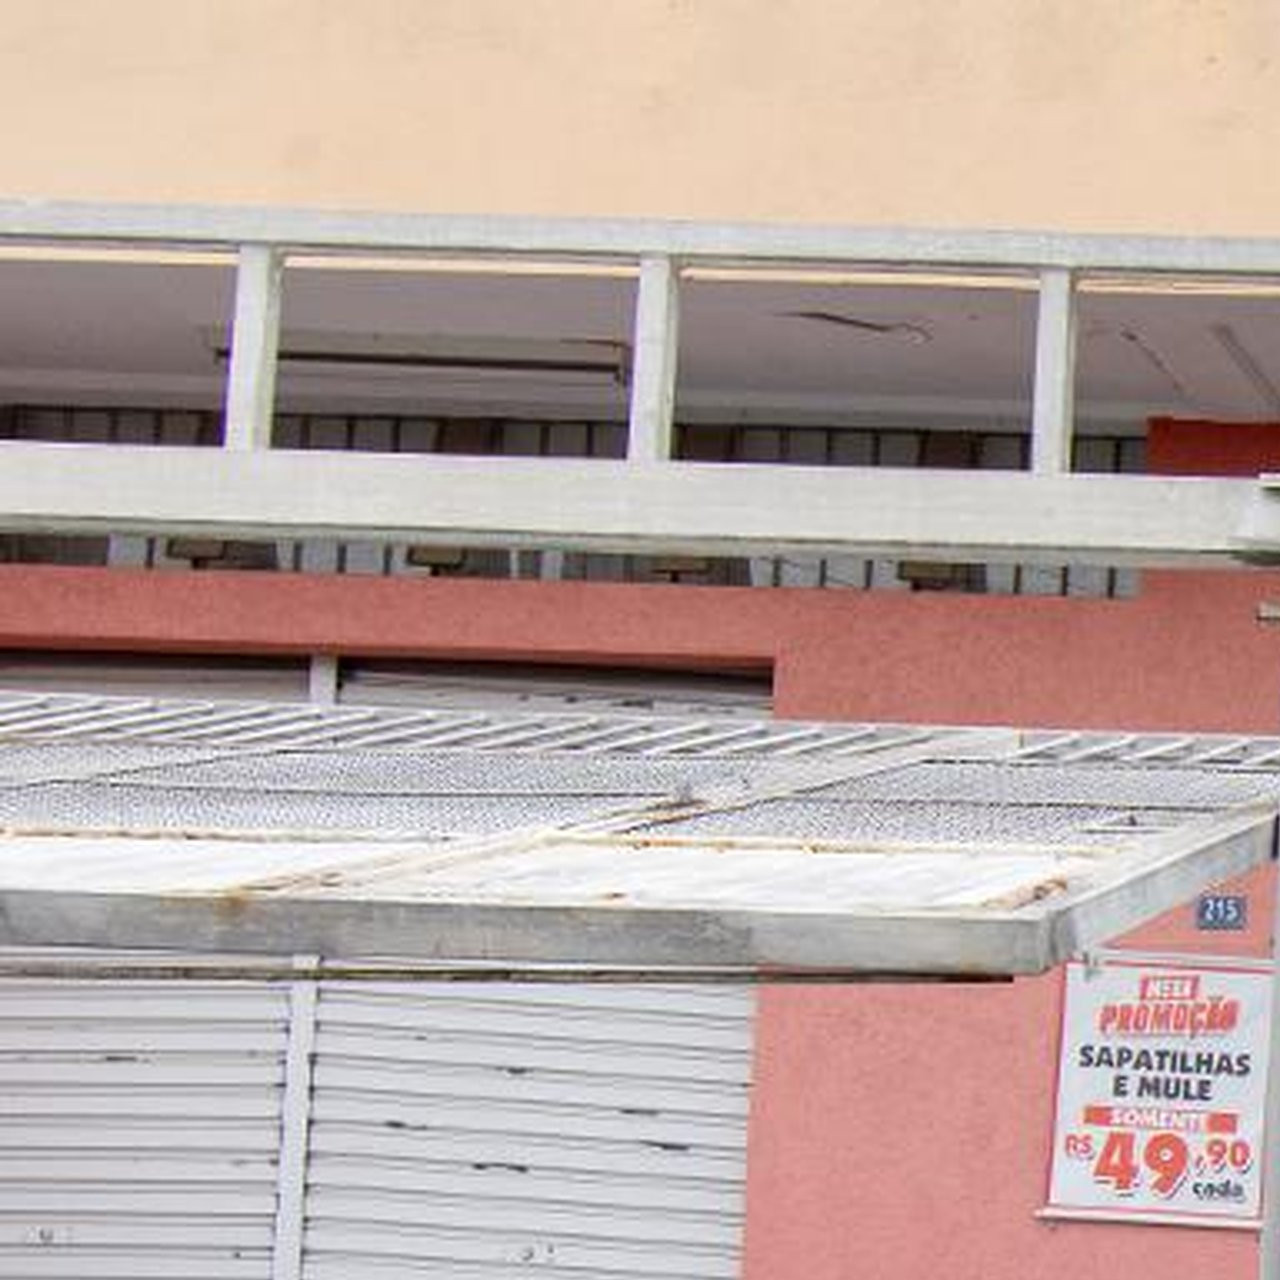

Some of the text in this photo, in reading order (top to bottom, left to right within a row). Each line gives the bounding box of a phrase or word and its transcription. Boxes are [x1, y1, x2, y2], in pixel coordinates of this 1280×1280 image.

[1205, 899, 1238, 921] 215
[1079, 1045, 1251, 1075] SAPATILHAS
[1113, 1076, 1212, 1101] E MULE
